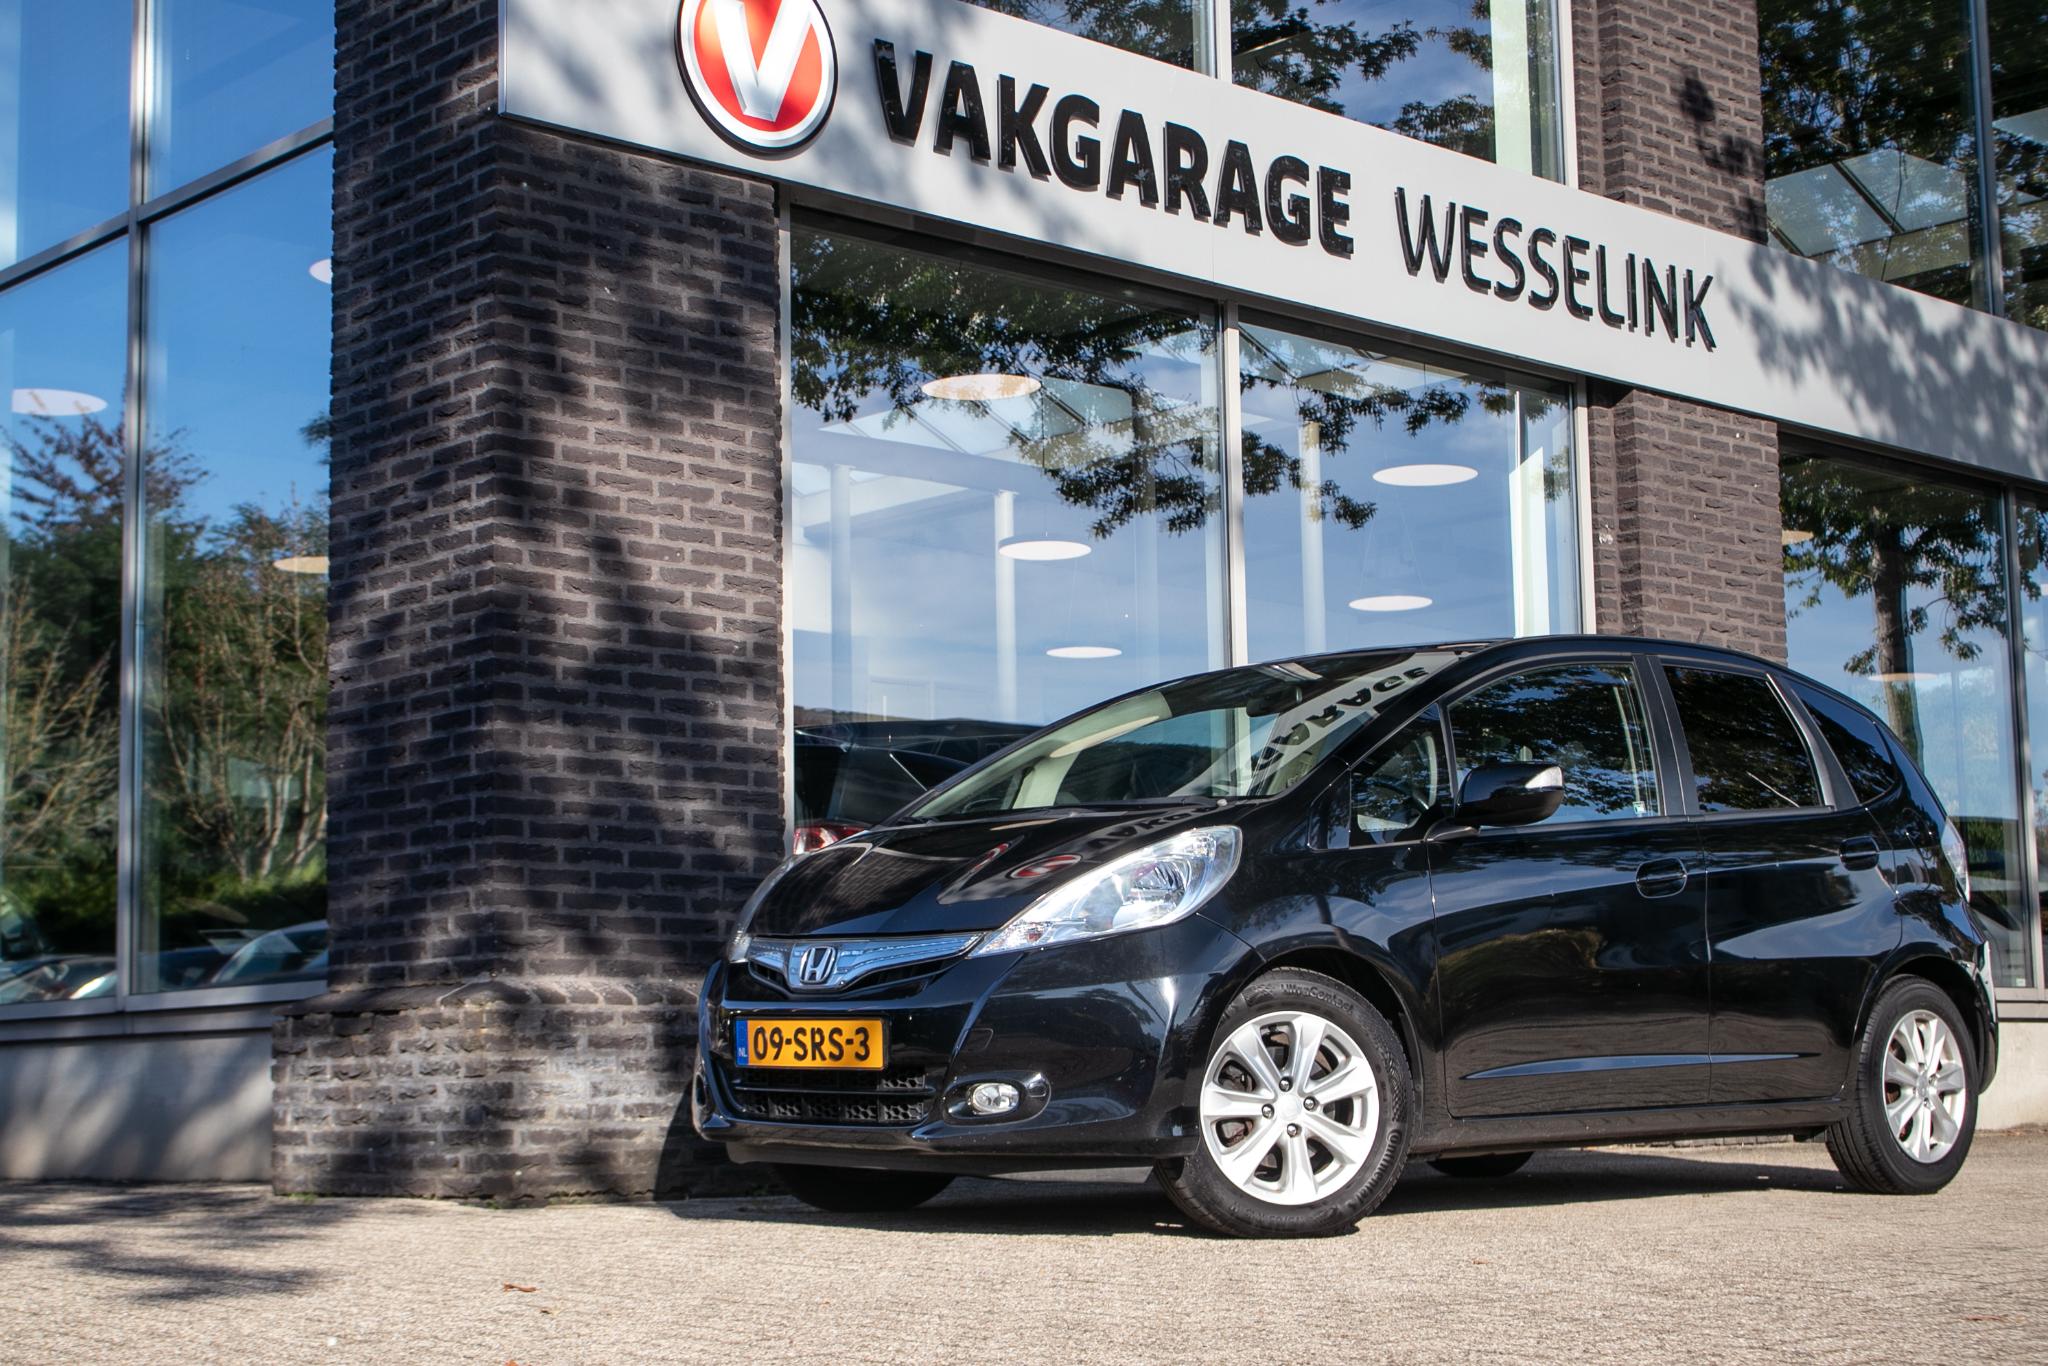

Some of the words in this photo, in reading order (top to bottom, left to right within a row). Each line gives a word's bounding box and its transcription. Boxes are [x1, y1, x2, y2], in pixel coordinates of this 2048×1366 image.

[874, 38, 1355, 259] VAKGARAGE
[1394, 186, 1717, 353] WESSELINK
[753, 1026, 871, 1062] 09-SRS-3
[1354, 1129, 1403, 1203] Continental
